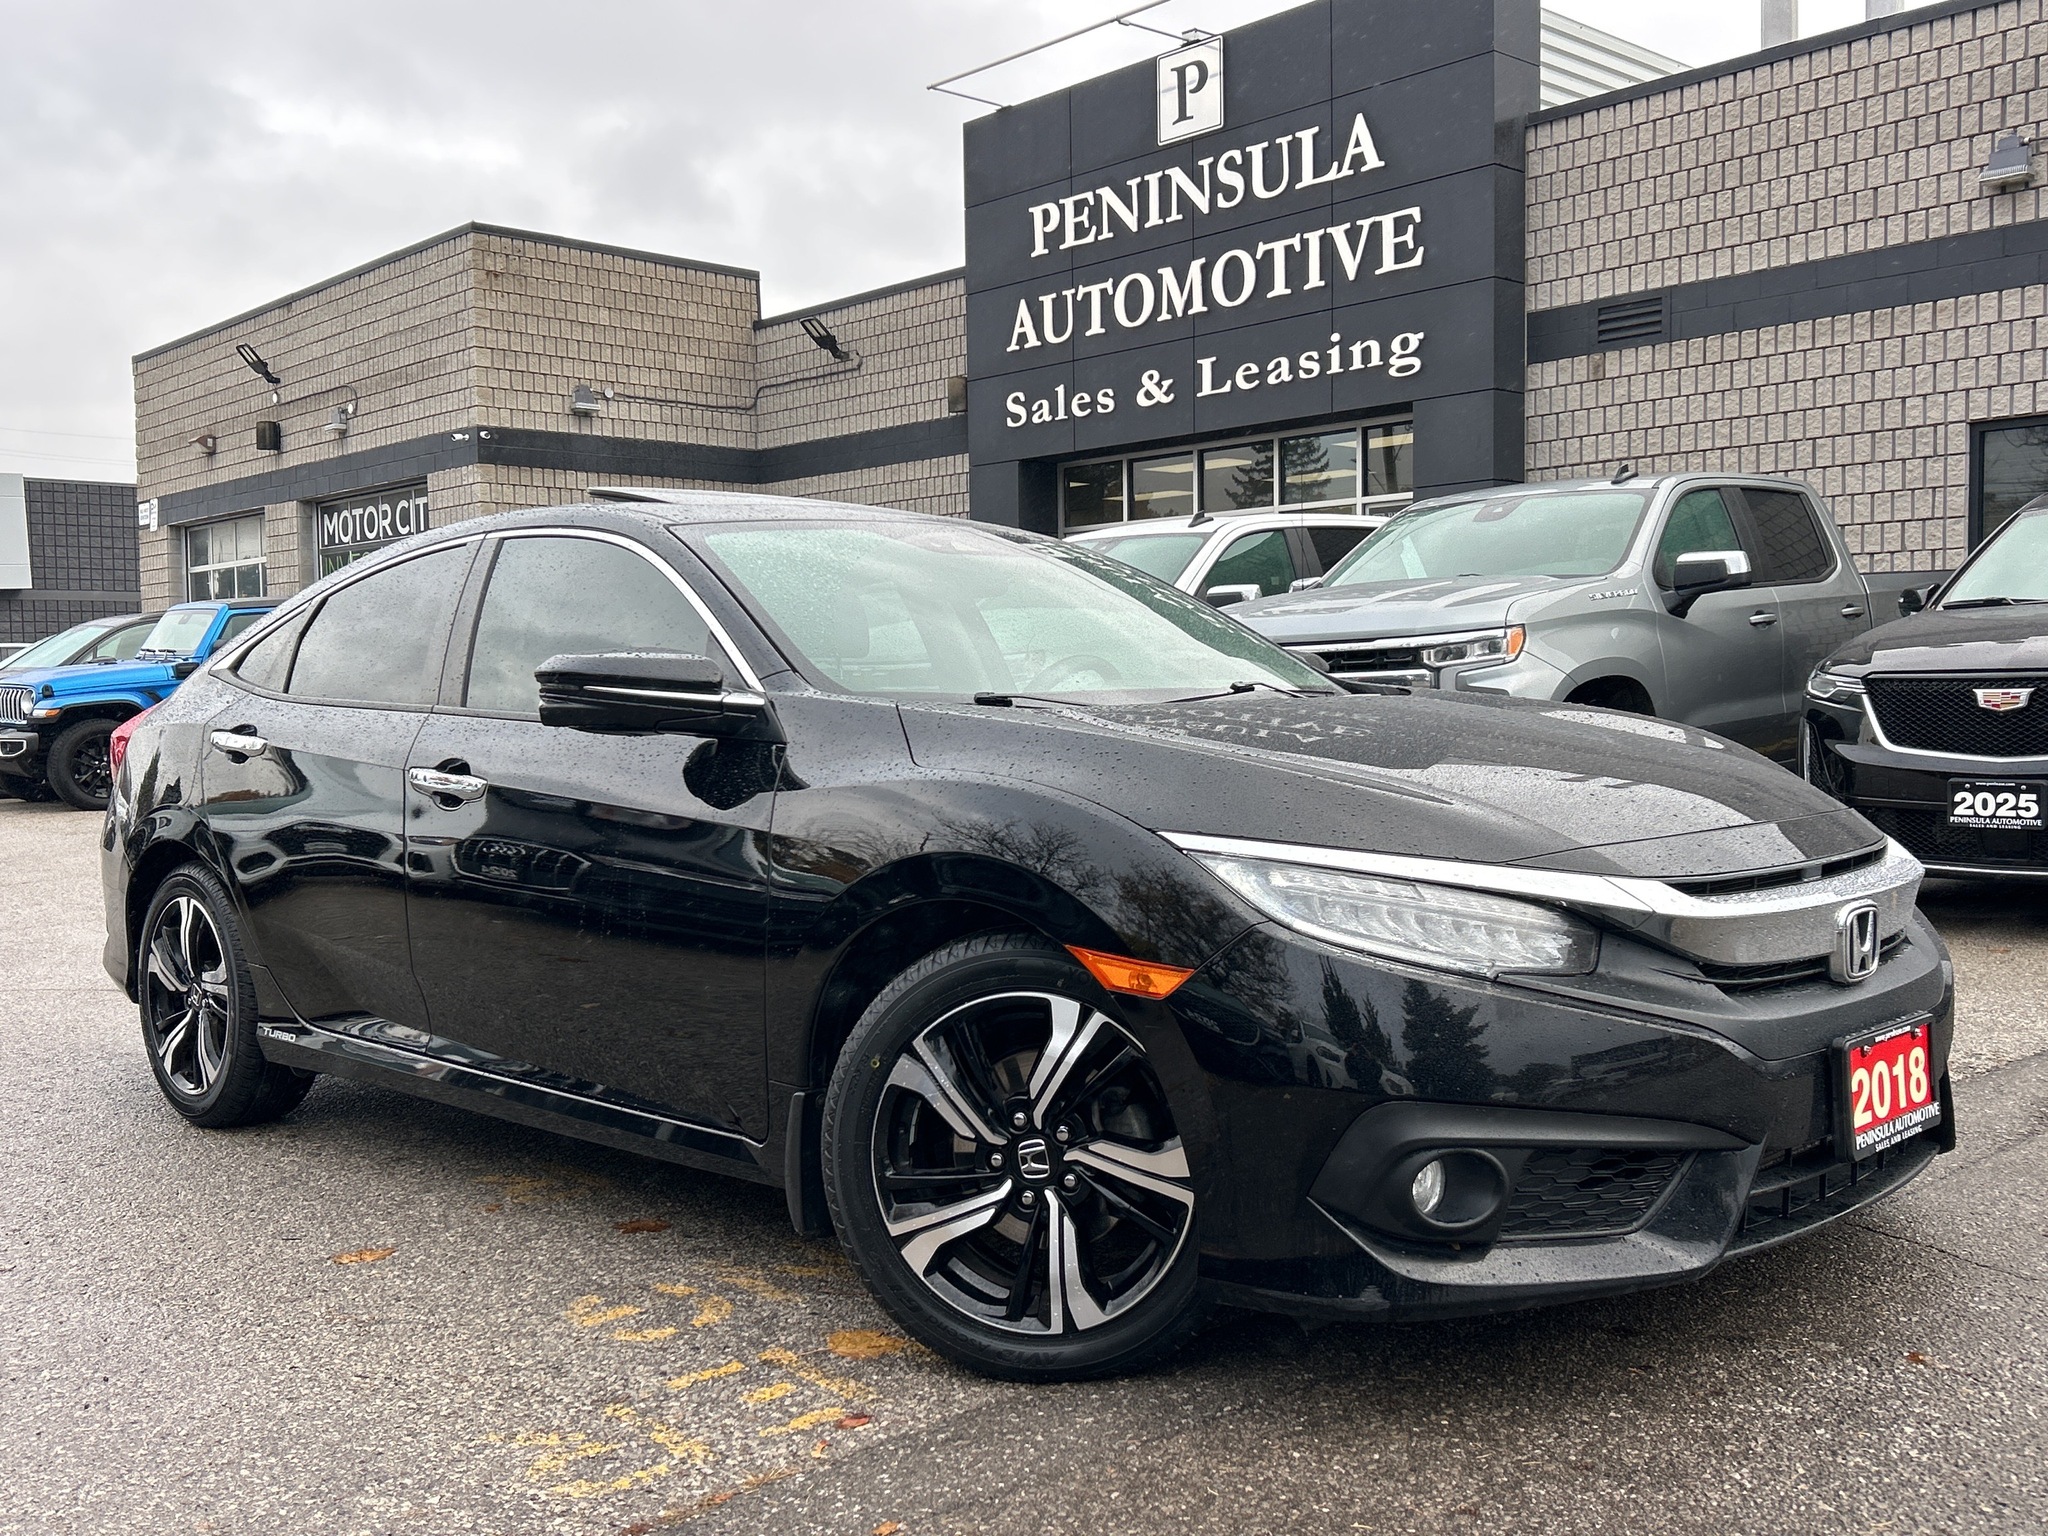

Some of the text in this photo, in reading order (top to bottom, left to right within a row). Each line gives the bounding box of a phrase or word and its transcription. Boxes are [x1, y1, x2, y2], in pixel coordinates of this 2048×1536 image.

[1170, 59, 1209, 126] P
[1028, 112, 1385, 258] PENINSULA
[1006, 206, 1425, 353] AUTOMOTIVE
[1006, 331, 1425, 428] Sales & Leasing
[323, 496, 428, 545] MOTOR CIT
[1949, 816, 2042, 826] PENINSULA AUTOMOTIVE
[1953, 791, 2039, 818] 2025
[263, 1026, 296, 1042] TURBO
[1851, 1046, 1928, 1129] 2018
[1855, 1101, 1940, 1151] PENINSULA AUTOMOTIVE
[1875, 1139, 1890, 1152] SALES
[1902, 1124, 1922, 1140] LEASING
